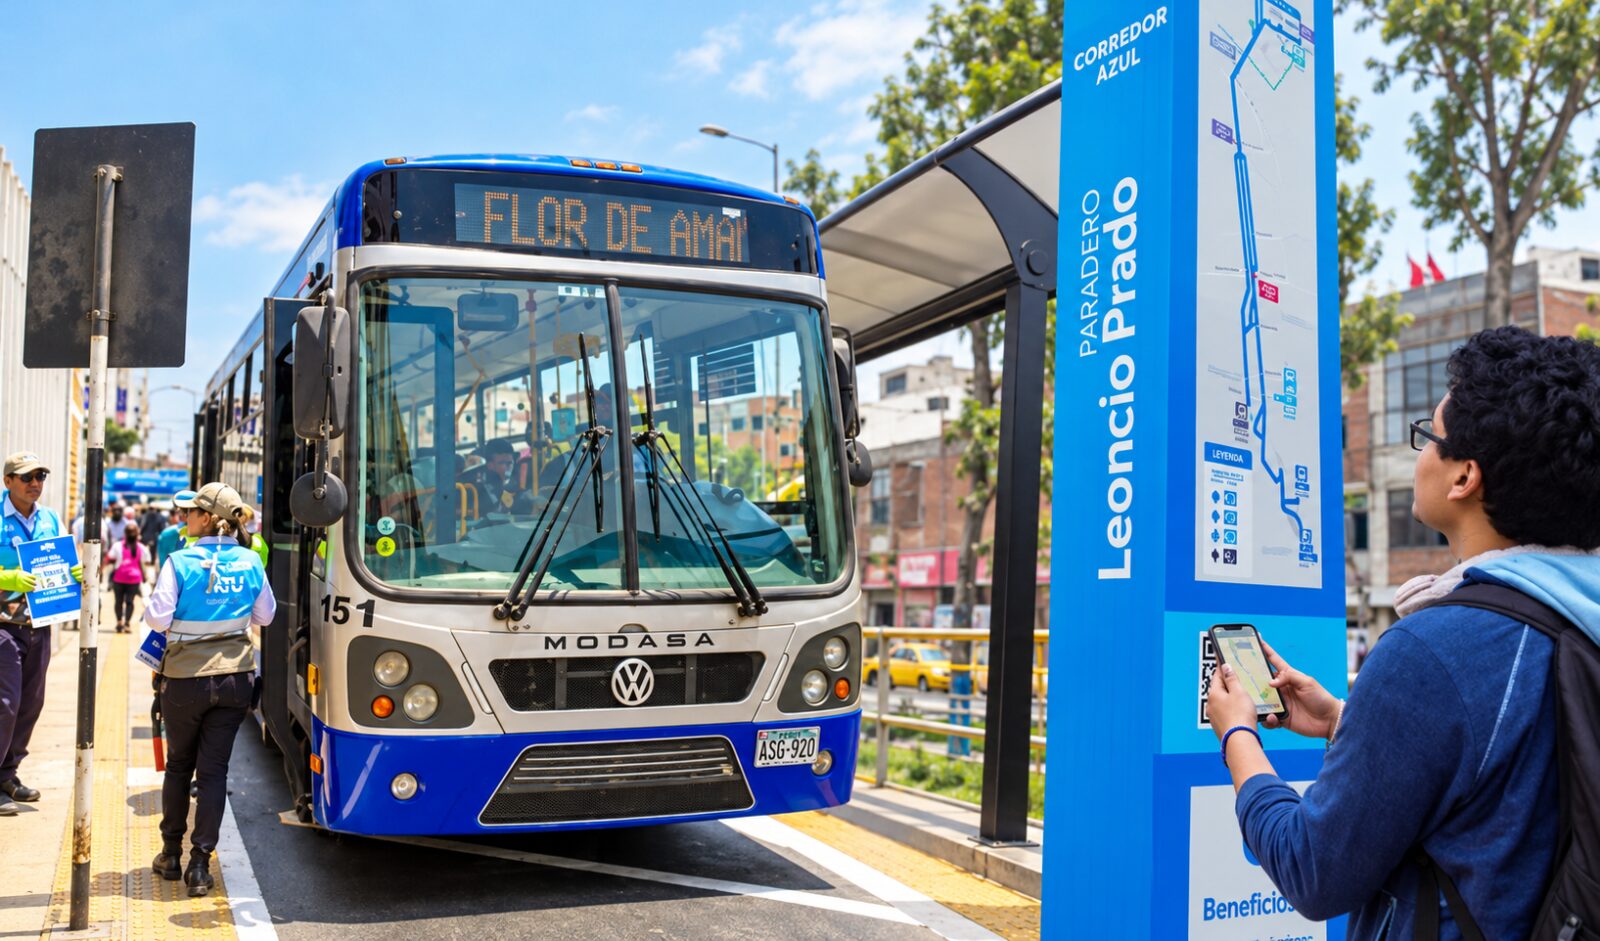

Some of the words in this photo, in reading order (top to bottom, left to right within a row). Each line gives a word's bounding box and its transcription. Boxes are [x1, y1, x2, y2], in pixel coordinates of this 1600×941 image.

[1073, 6, 1168, 71] CORREDOR
[1095, 47, 1141, 86] AZUL
[483, 191, 589, 248] FLOR
[607, 202, 652, 254] DE
[1079, 188, 1101, 358] PARADERO
[1101, 176, 1139, 343] Prado
[1098, 354, 1136, 580] Leoncio
[1212, 449, 1244, 464] LEYENDA
[320, 594, 376, 628] 151
[544, 632, 715, 650] MODASA
[758, 737, 816, 761] ASG-920
